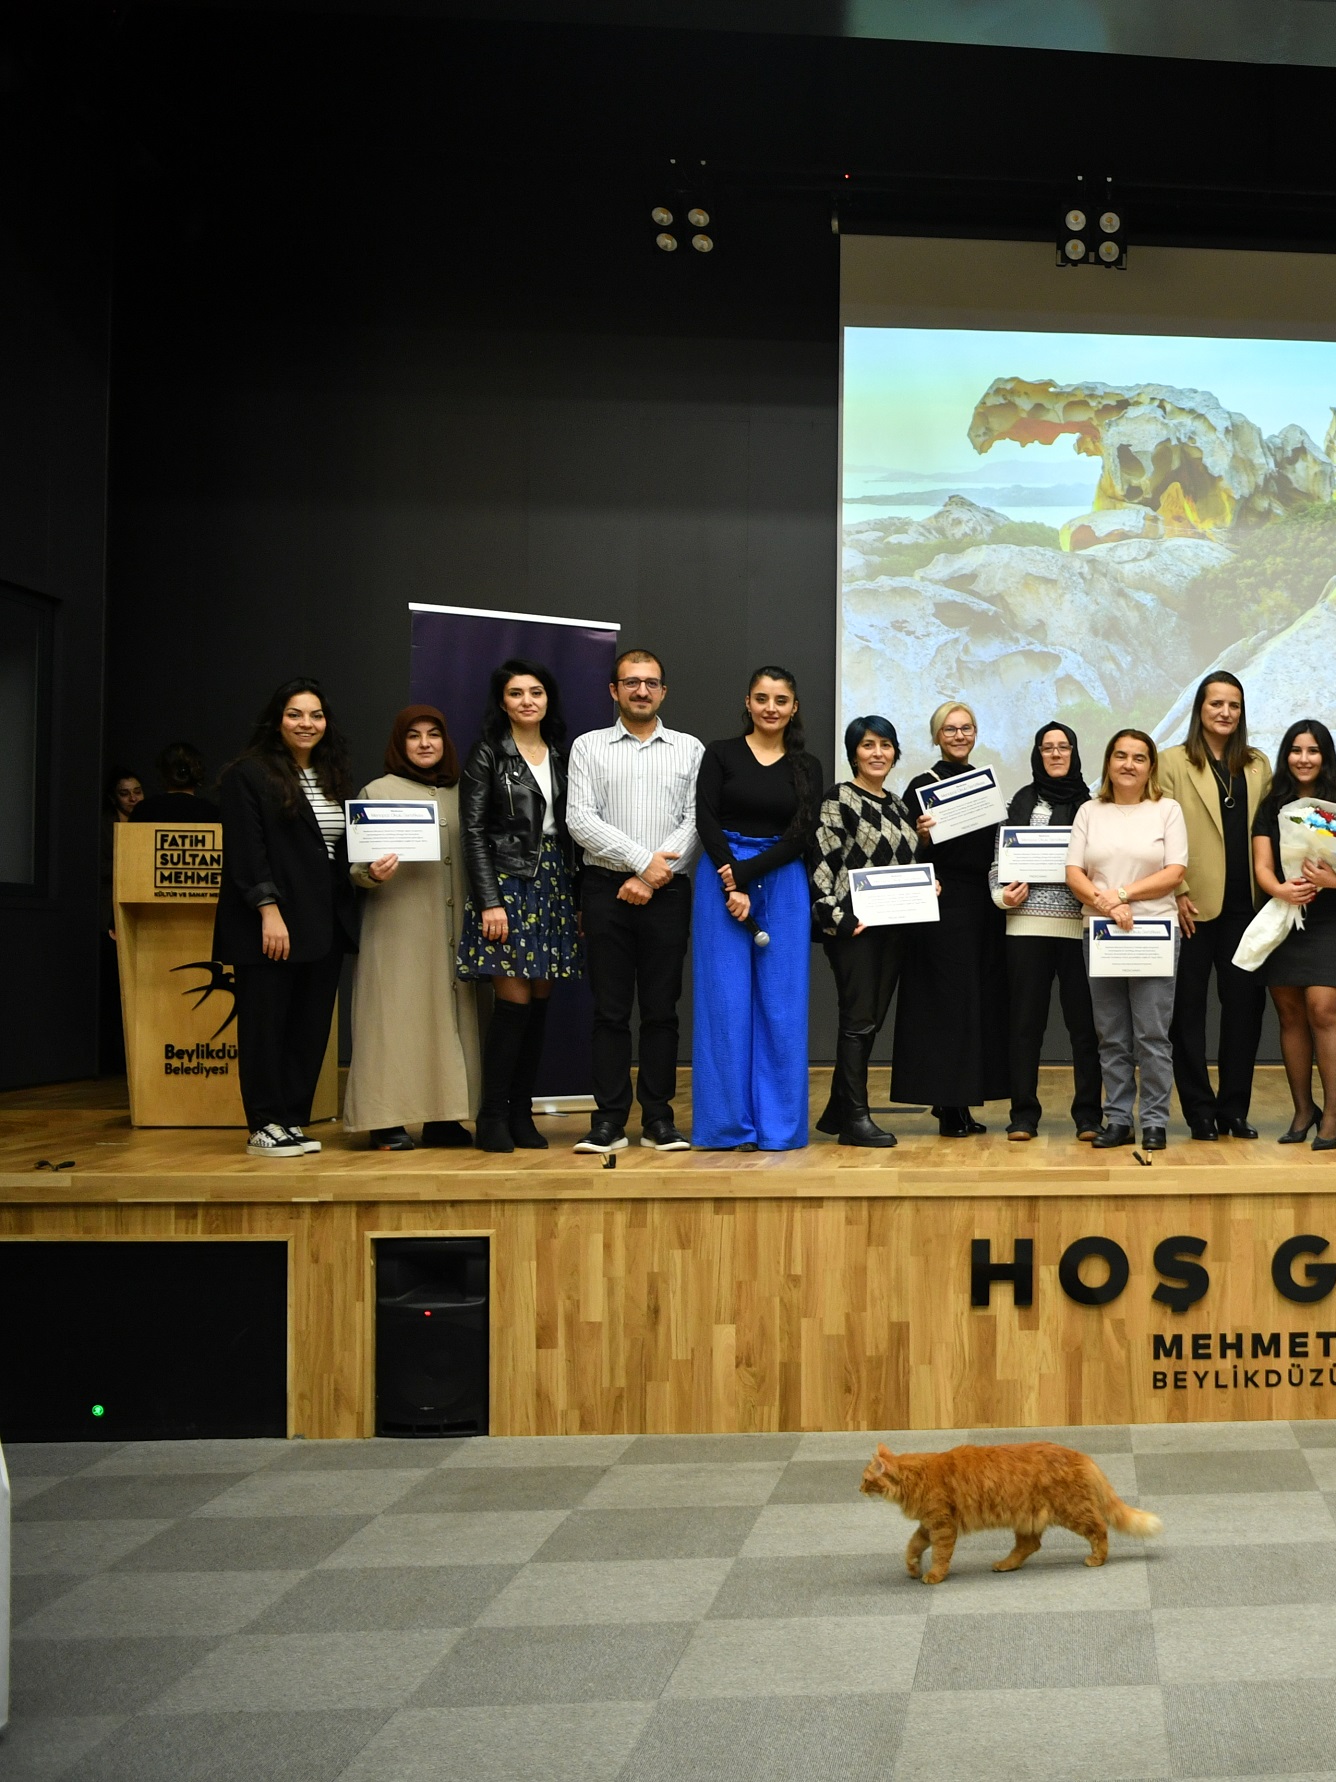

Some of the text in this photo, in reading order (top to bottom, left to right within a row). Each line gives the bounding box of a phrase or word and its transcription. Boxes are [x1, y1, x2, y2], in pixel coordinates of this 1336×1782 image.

[160, 833, 206, 849] FATİH
[160, 850, 221, 867] SULTAN
[160, 871, 222, 885] MEHME
[154, 890, 178, 898] KÜLTÜR
[164, 1042, 238, 1063] Beylikdü
[164, 1061, 228, 1079] Belediyesi
[970, 1235, 1210, 1313] HOŞ
